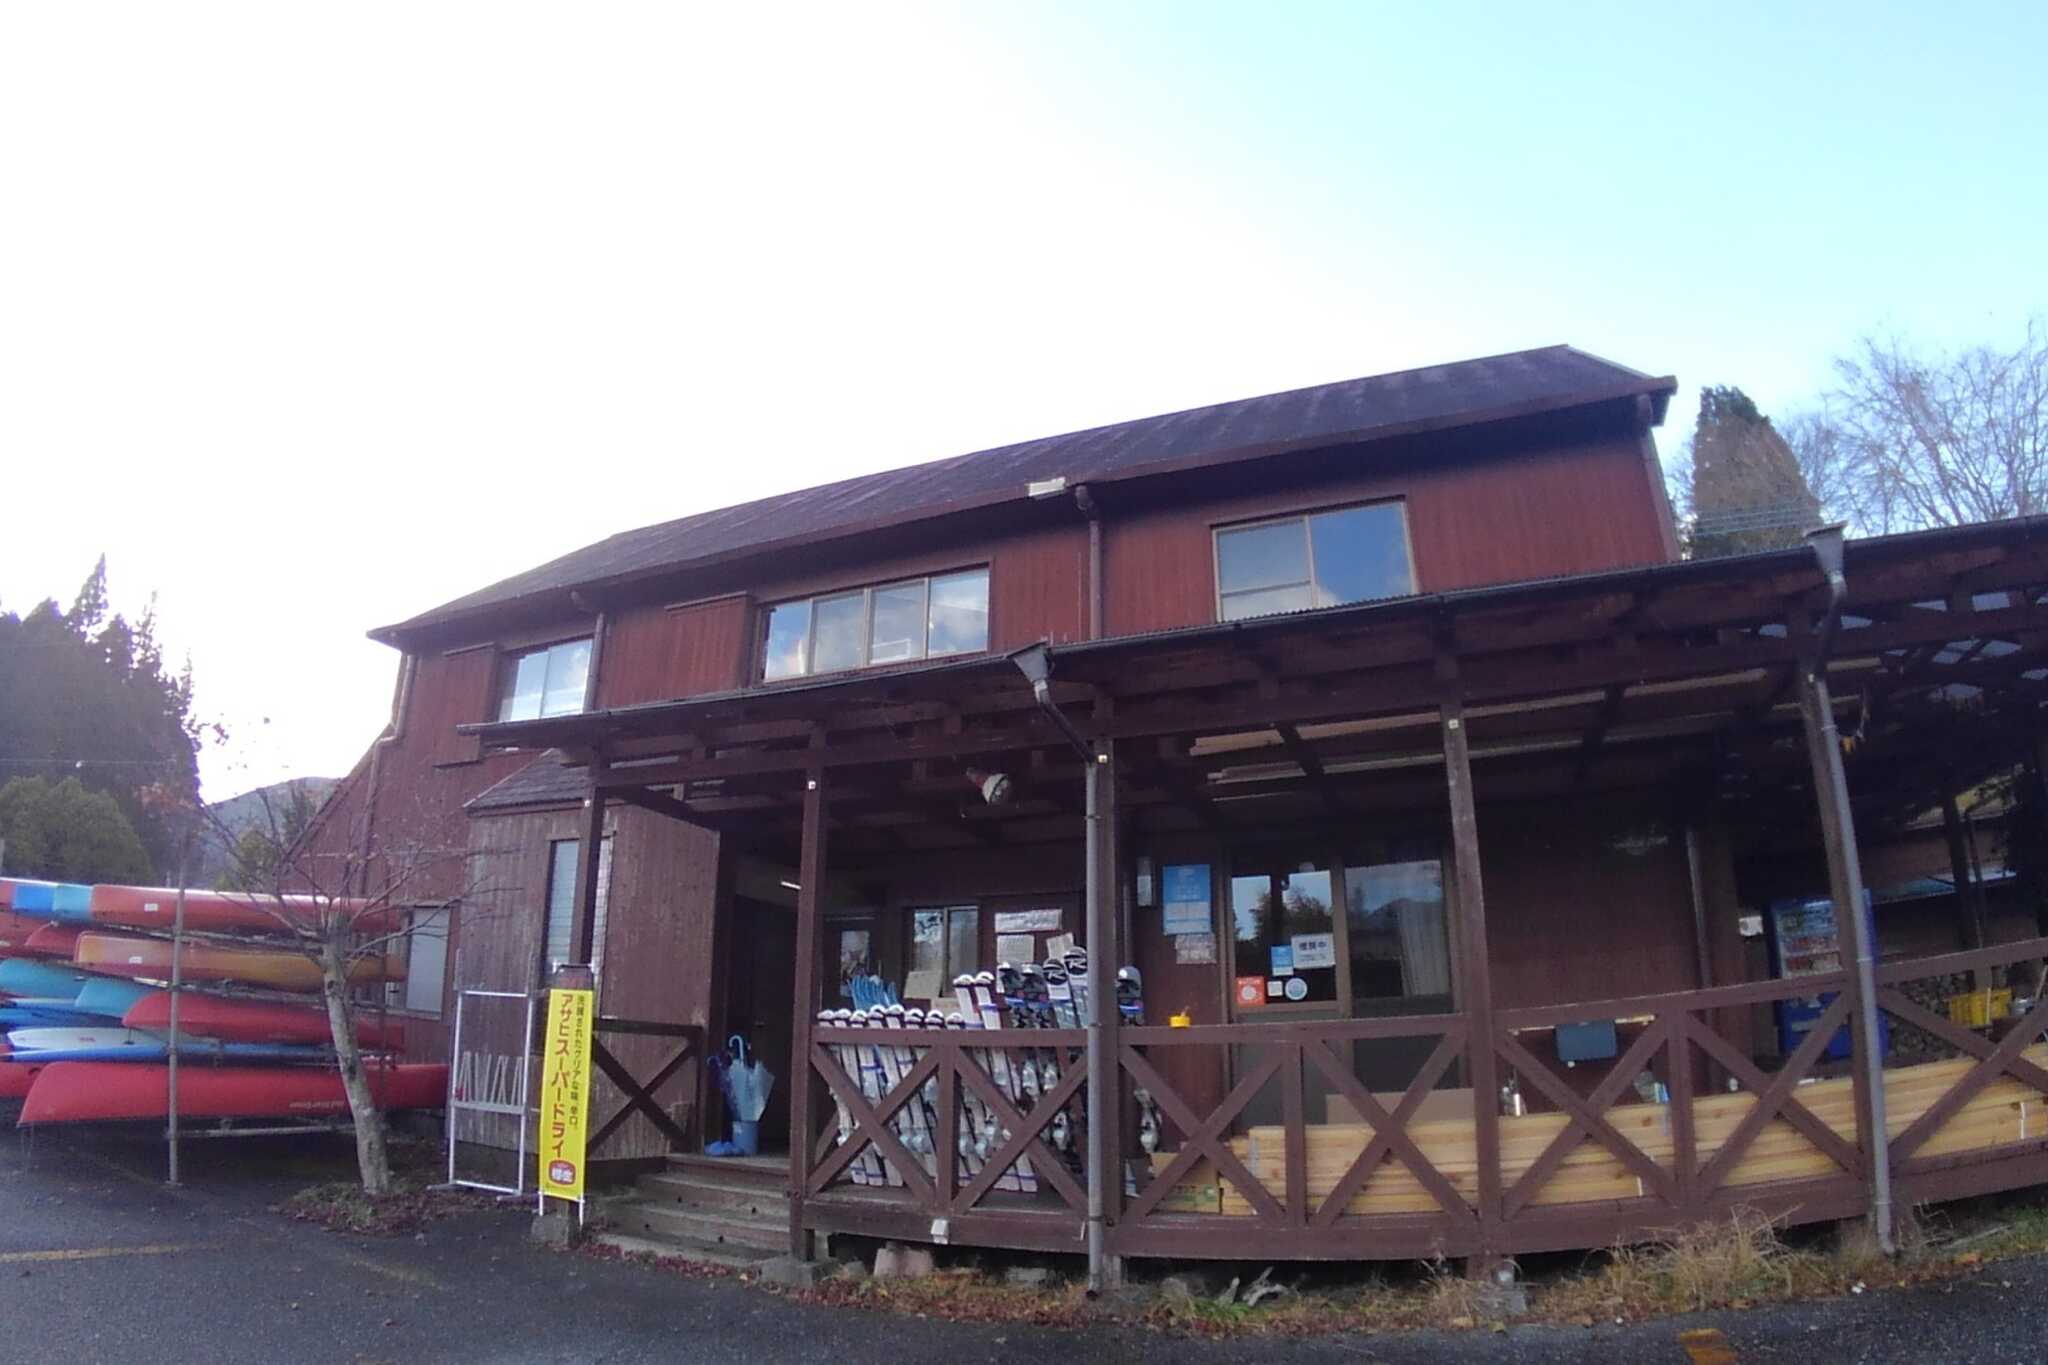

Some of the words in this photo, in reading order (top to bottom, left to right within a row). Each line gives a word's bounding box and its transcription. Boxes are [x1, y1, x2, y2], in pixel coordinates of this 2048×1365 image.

[553, 994, 573, 1158] アサヒスーパードライ
